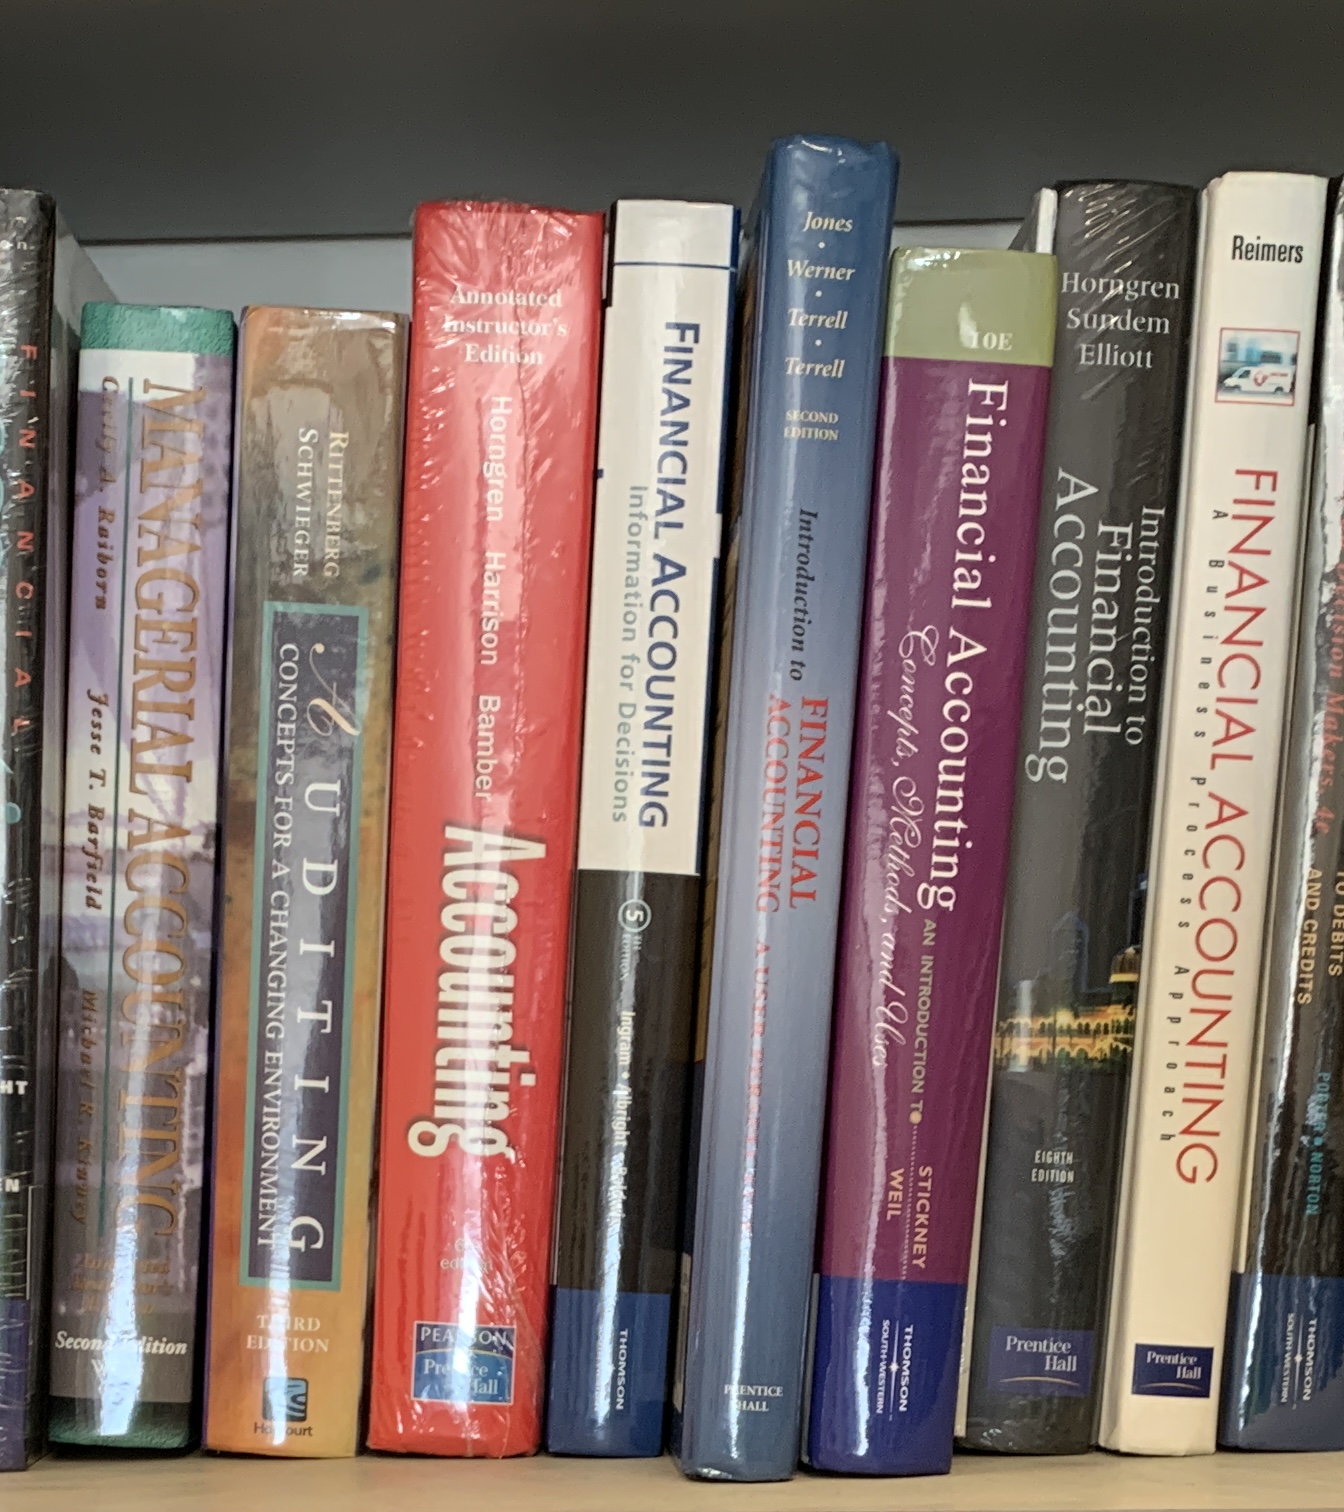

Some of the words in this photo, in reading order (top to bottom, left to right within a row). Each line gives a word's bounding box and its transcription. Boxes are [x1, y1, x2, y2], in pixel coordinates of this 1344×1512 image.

[803, 213, 853, 233] Jones
[1231, 236, 1304, 264] Reimers
[786, 259, 855, 282] Werner
[1062, 272, 1180, 299] Horngren
[788, 309, 848, 329] Terrell
[1066, 309, 1170, 334] Sundem
[1078, 343, 1154, 369] Elliott
[655, 320, 701, 538] FINANCIAL
[949, 377, 1010, 608] Financial
[1209, 469, 1278, 772] FINANCIAL
[639, 554, 688, 828] ACCOUNTING
[917, 626, 988, 912] Accounting
[1175, 784, 1255, 1184] ACCOUNTING
[1147, 1351, 1197, 1366] Prentice
[1177, 1365, 1202, 1380] Hall
